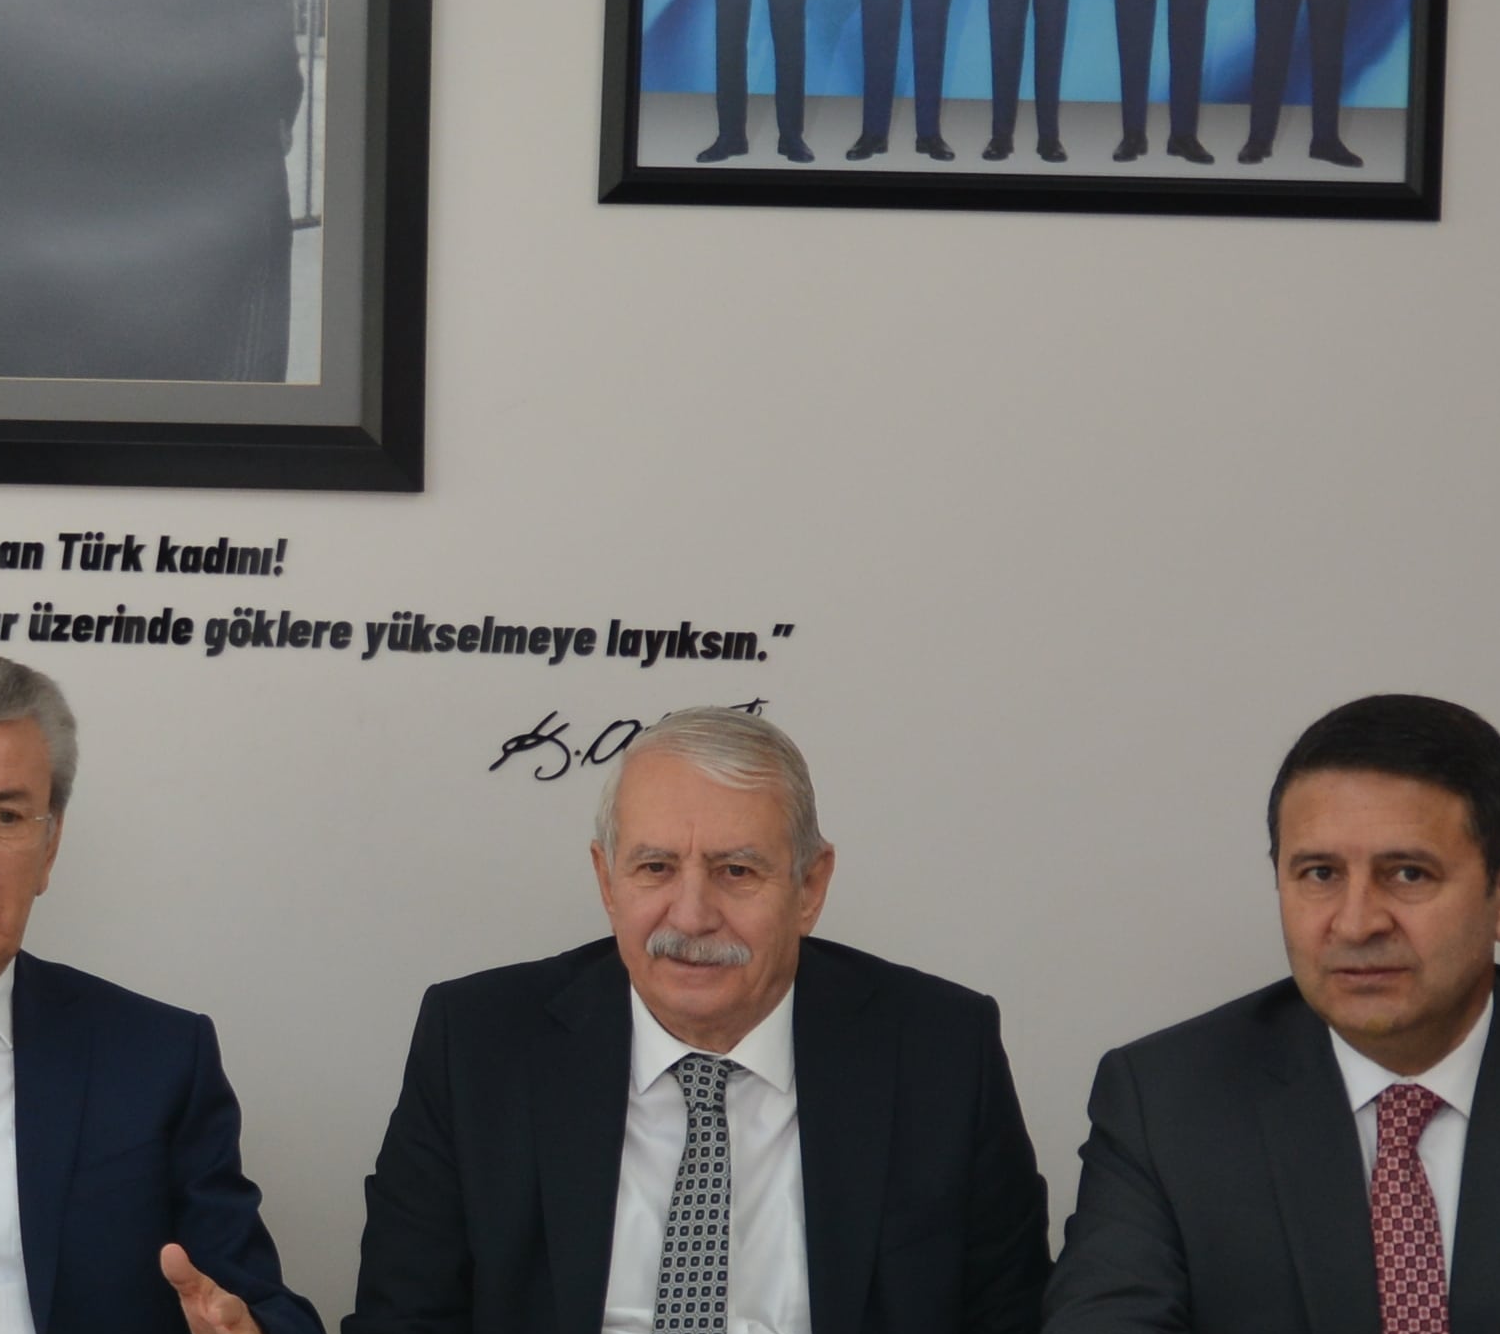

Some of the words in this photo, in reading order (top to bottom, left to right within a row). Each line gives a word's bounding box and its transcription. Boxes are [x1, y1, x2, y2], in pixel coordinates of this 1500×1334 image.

[58, 531, 146, 573] Türk
[155, 535, 289, 577] kadını!
[27, 601, 195, 646] üzerinde
[204, 606, 353, 658] göklere
[361, 610, 597, 666] yükselmeye
